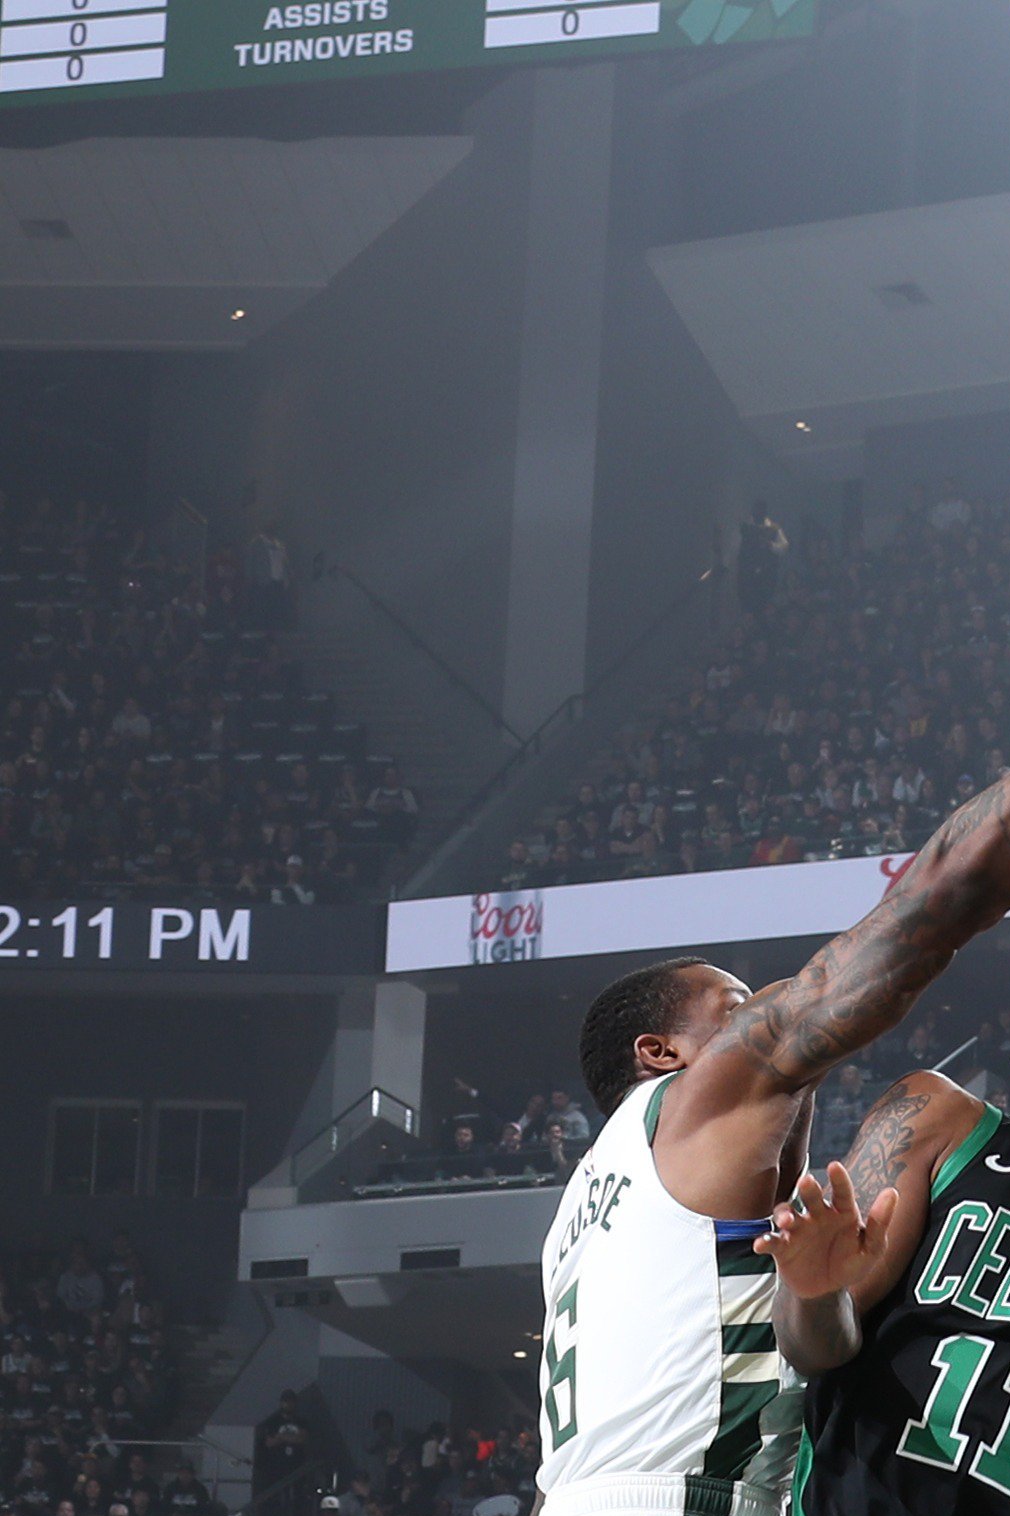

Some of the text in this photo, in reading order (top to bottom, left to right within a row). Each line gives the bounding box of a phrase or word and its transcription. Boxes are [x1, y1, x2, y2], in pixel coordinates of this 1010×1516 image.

[66, 9, 579, 80] 0 TURNOVERS 0
[70, 0, 388, 46] 0 ASSISTS
[0, 905, 250, 961] 2:11 PM
